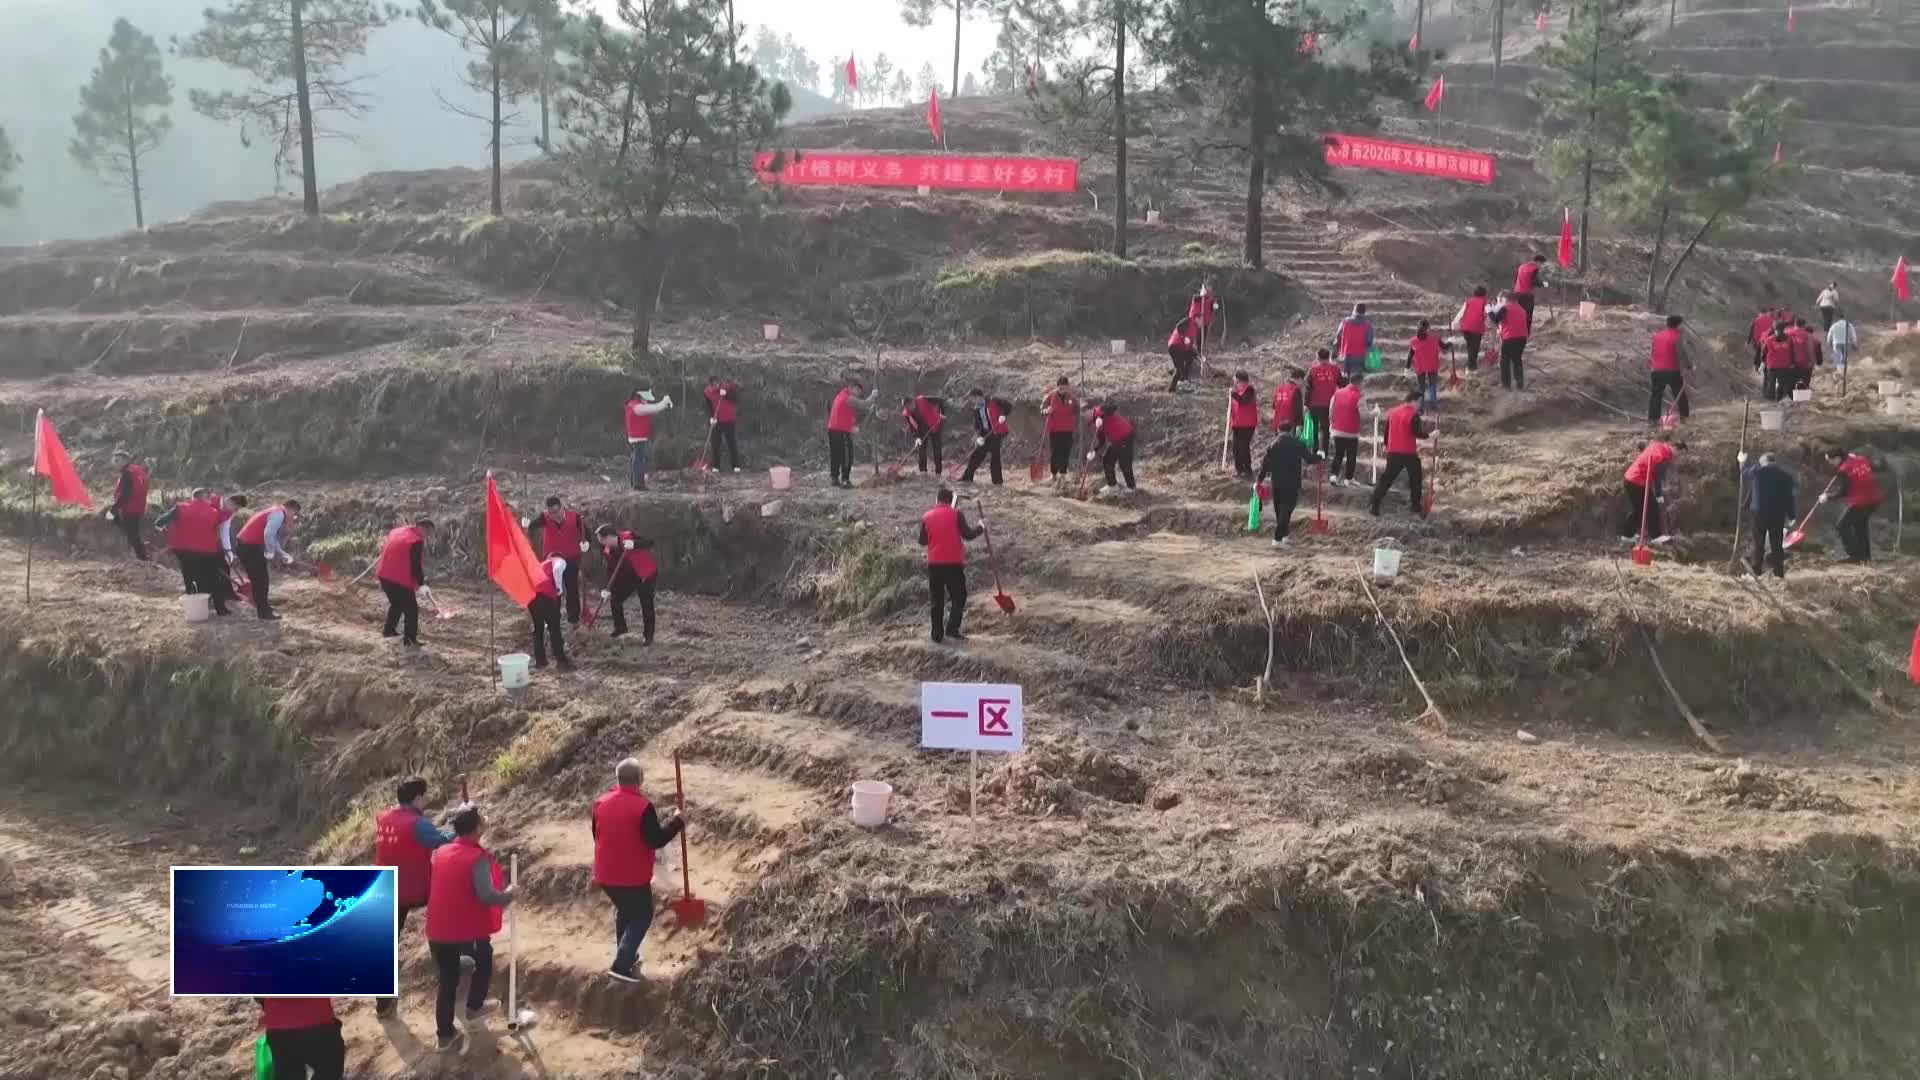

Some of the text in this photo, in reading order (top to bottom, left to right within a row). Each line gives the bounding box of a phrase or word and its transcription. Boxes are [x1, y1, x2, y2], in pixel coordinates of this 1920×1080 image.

[764, 158, 1066, 185] 行植树义务 共建美好乡村
[931, 698, 1013, 736] 一区
